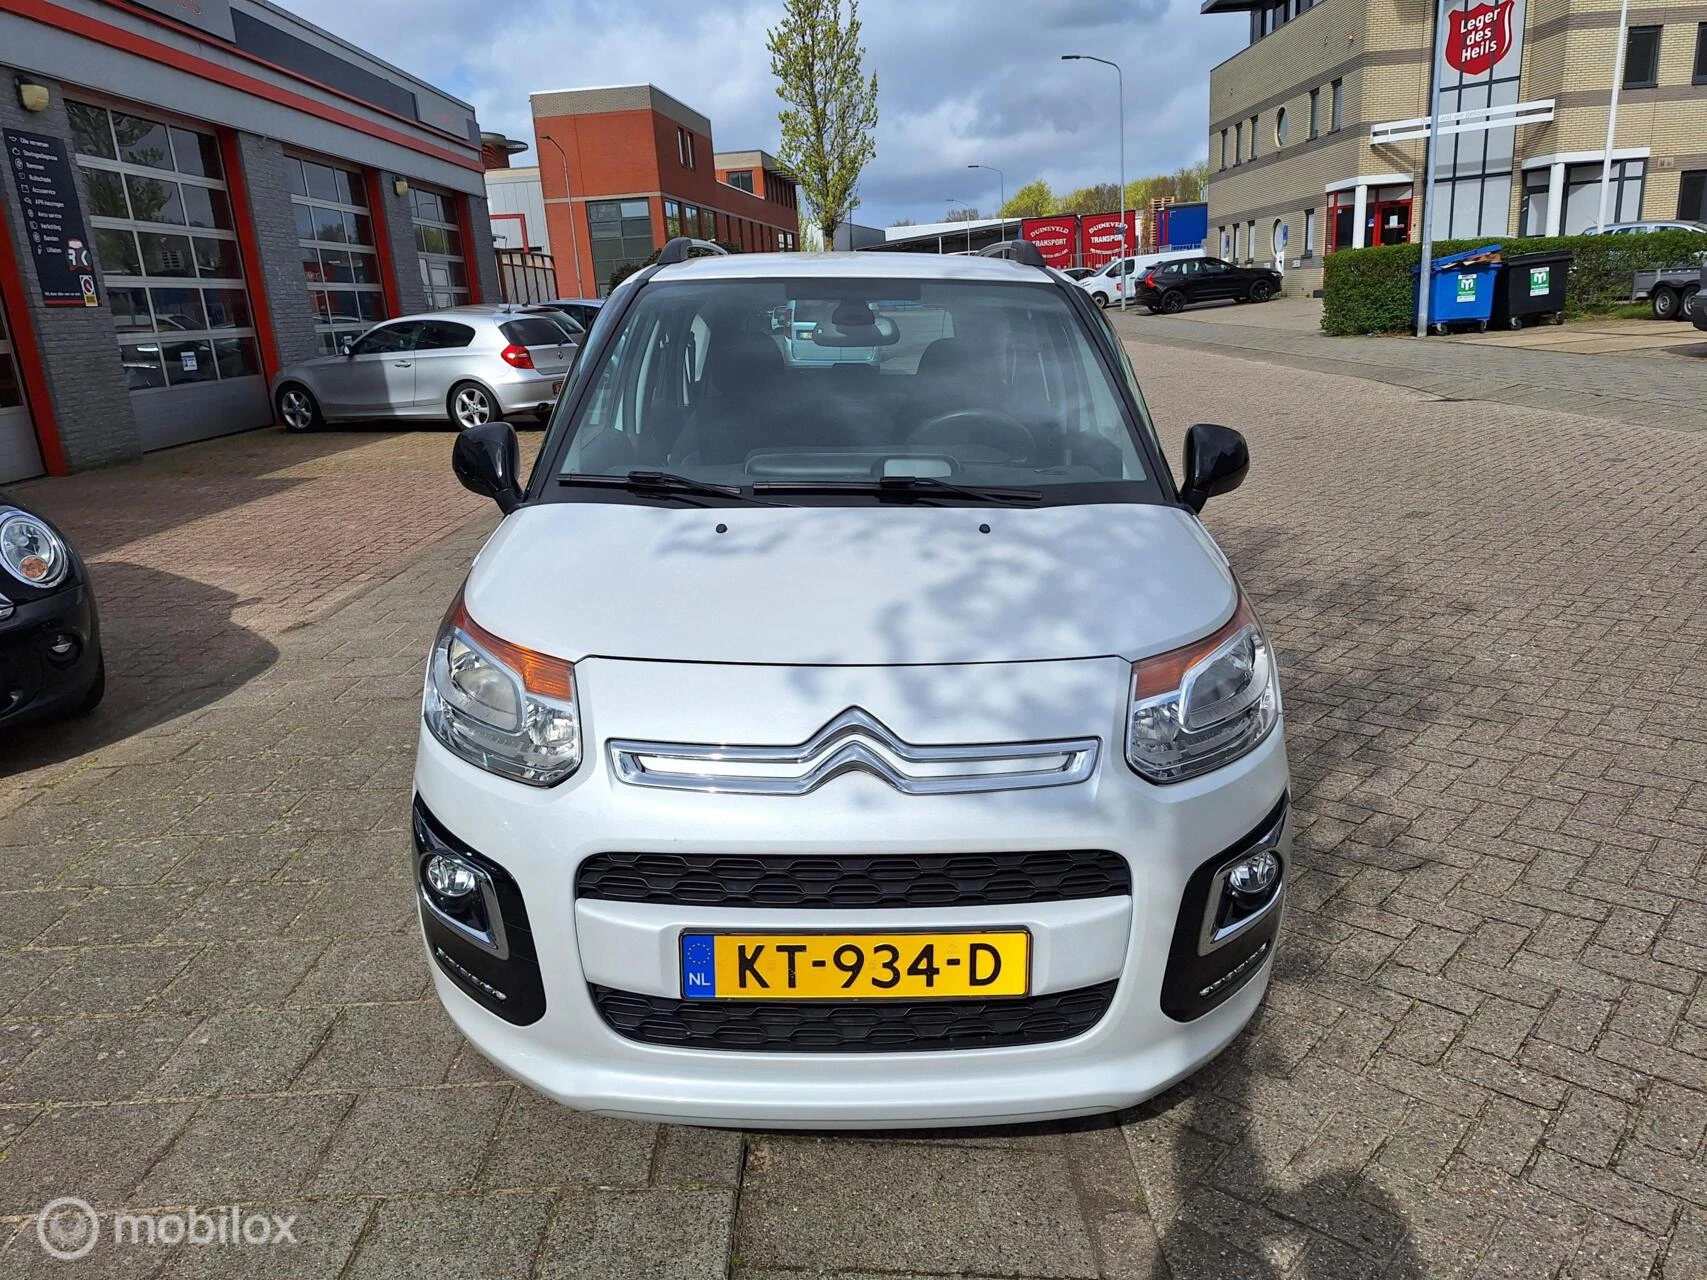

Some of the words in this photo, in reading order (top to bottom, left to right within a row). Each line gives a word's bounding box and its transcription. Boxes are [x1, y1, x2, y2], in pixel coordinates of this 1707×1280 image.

[1460, 8, 1501, 34] Leger
[1466, 28, 1492, 46] des
[1461, 40, 1497, 62] Heils
[1030, 226, 1069, 237] DUINEVELD
[737, 943, 1001, 989] KT-934-D
[688, 972, 711, 986] NL
